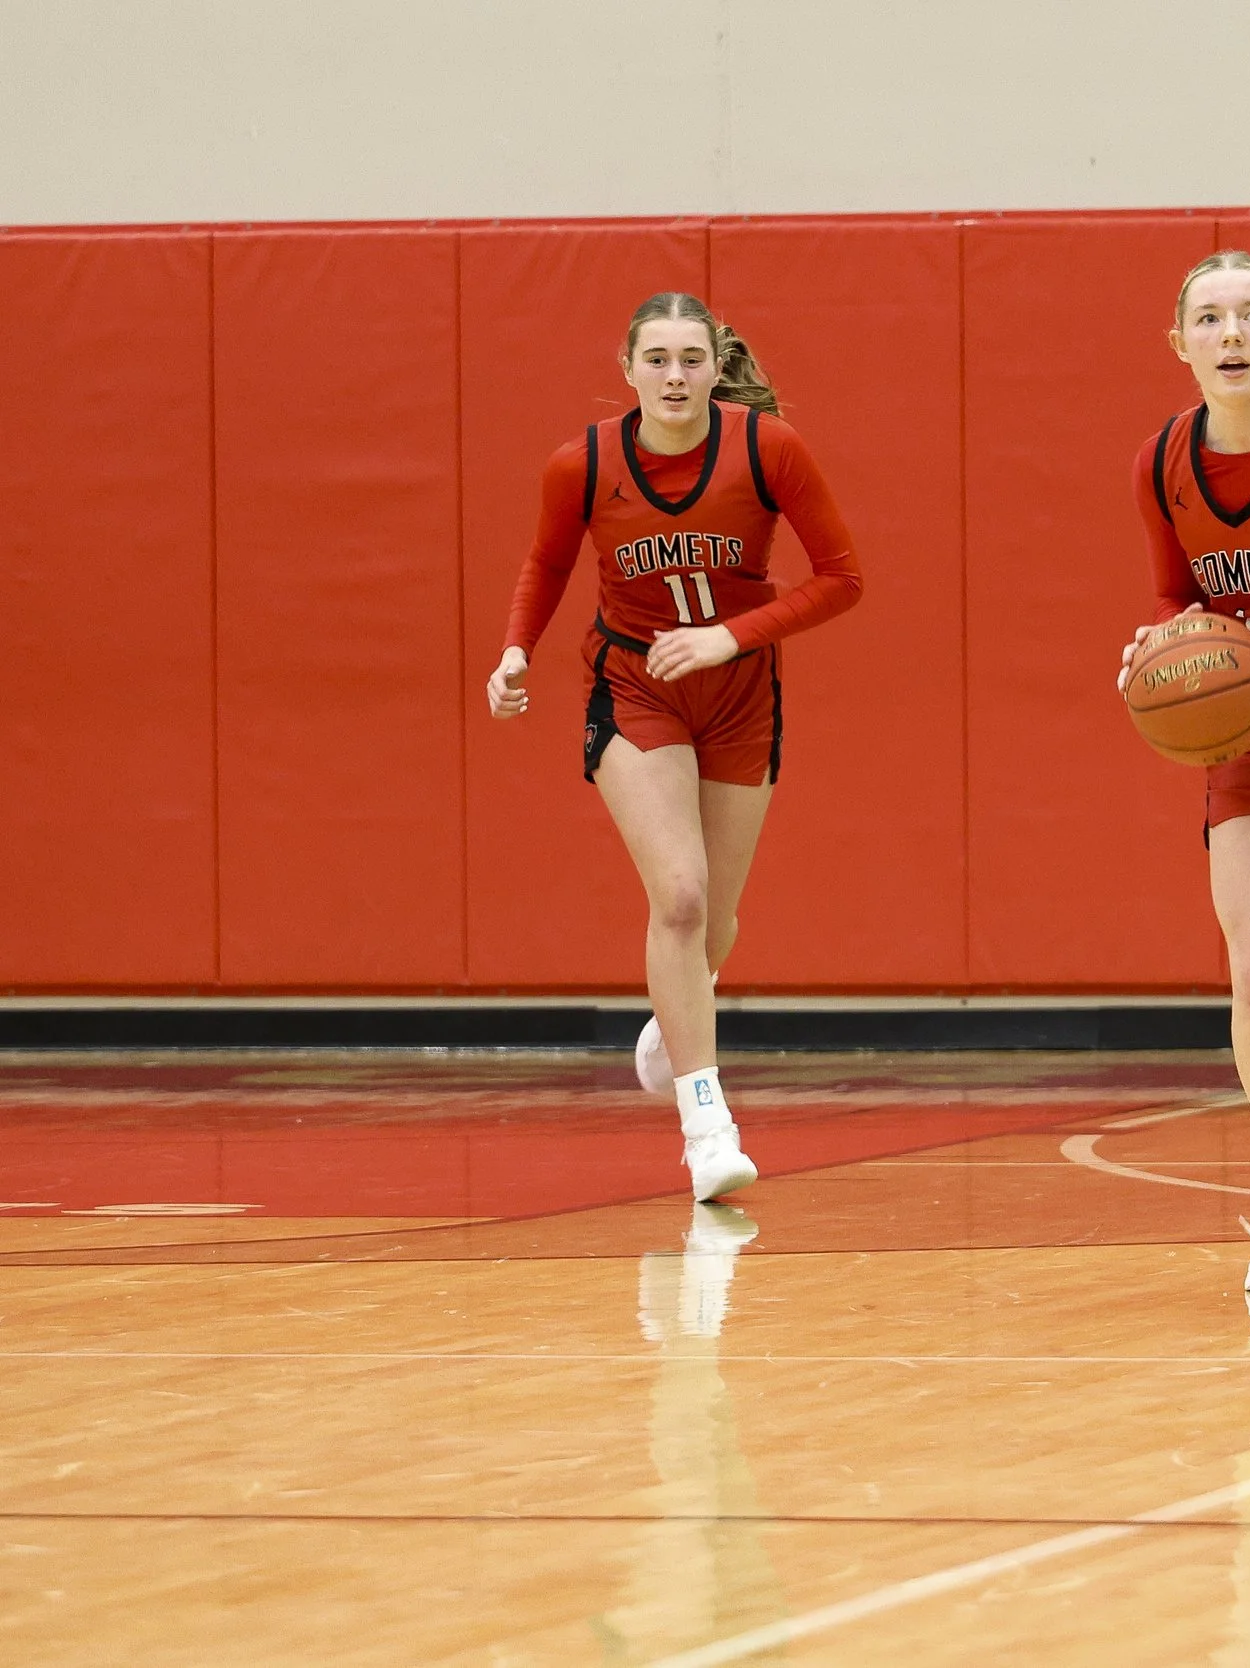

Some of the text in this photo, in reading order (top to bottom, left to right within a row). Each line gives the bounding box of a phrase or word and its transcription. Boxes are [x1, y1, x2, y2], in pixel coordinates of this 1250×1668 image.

[615, 532, 743, 580] COMETS
[663, 571, 716, 624] 11
[1143, 648, 1239, 694] SPALDING
